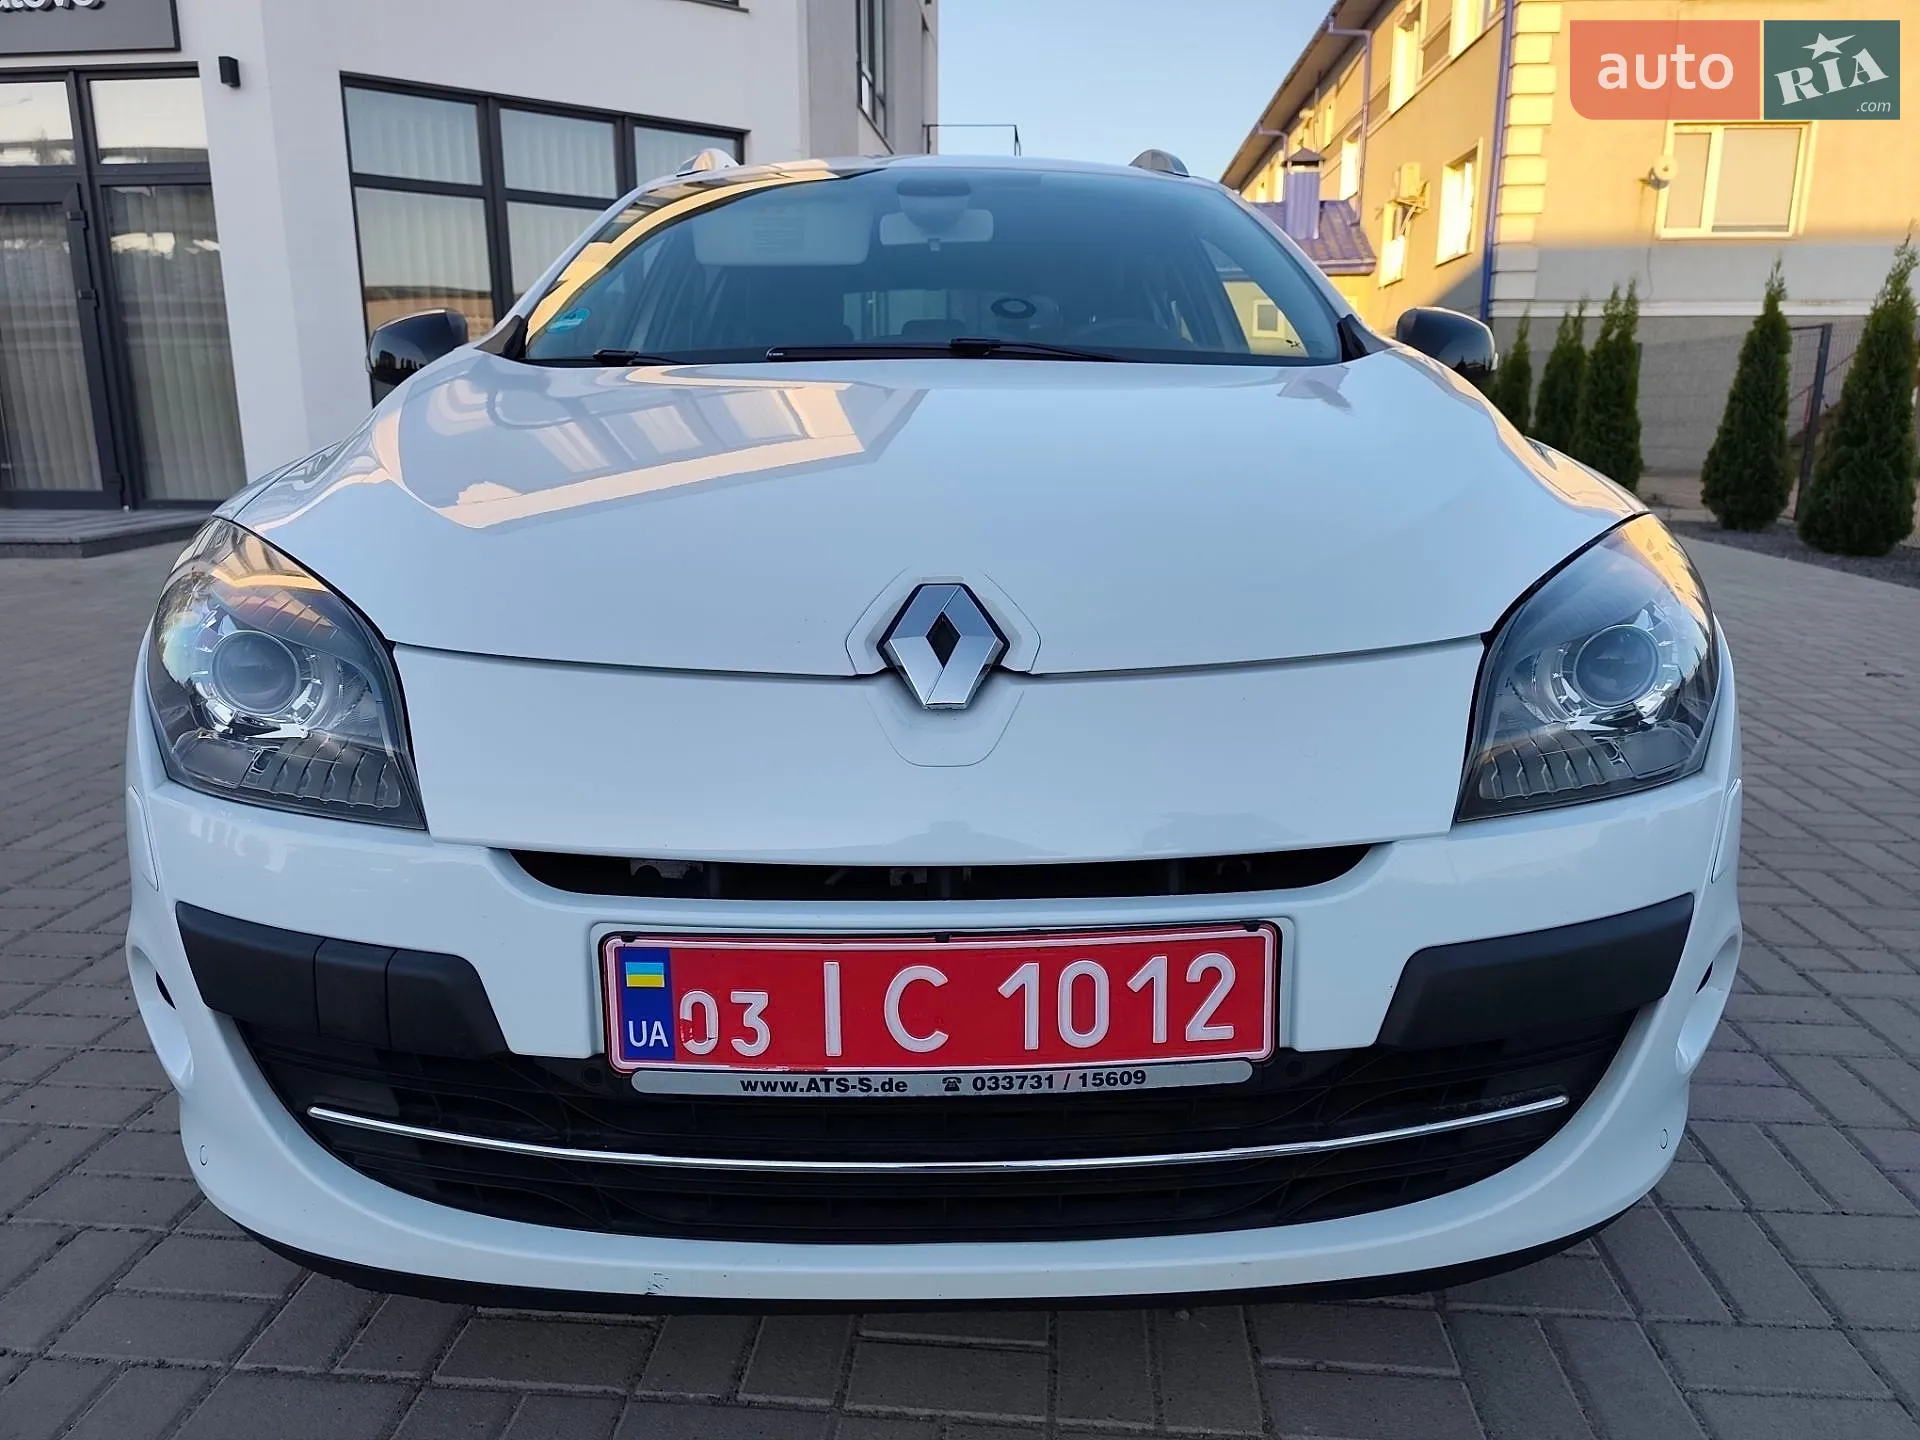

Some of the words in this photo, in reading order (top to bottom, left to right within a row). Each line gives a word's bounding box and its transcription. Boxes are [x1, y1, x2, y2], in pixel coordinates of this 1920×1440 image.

[679, 990, 771, 1057] 03
[998, 952, 1236, 1050] 1012
[628, 1020, 669, 1048] UA
[740, 1077, 908, 1093] www.ATS-S.de
[972, 1075, 1055, 1092] 033731
[1078, 1069, 1147, 1088] 15609
